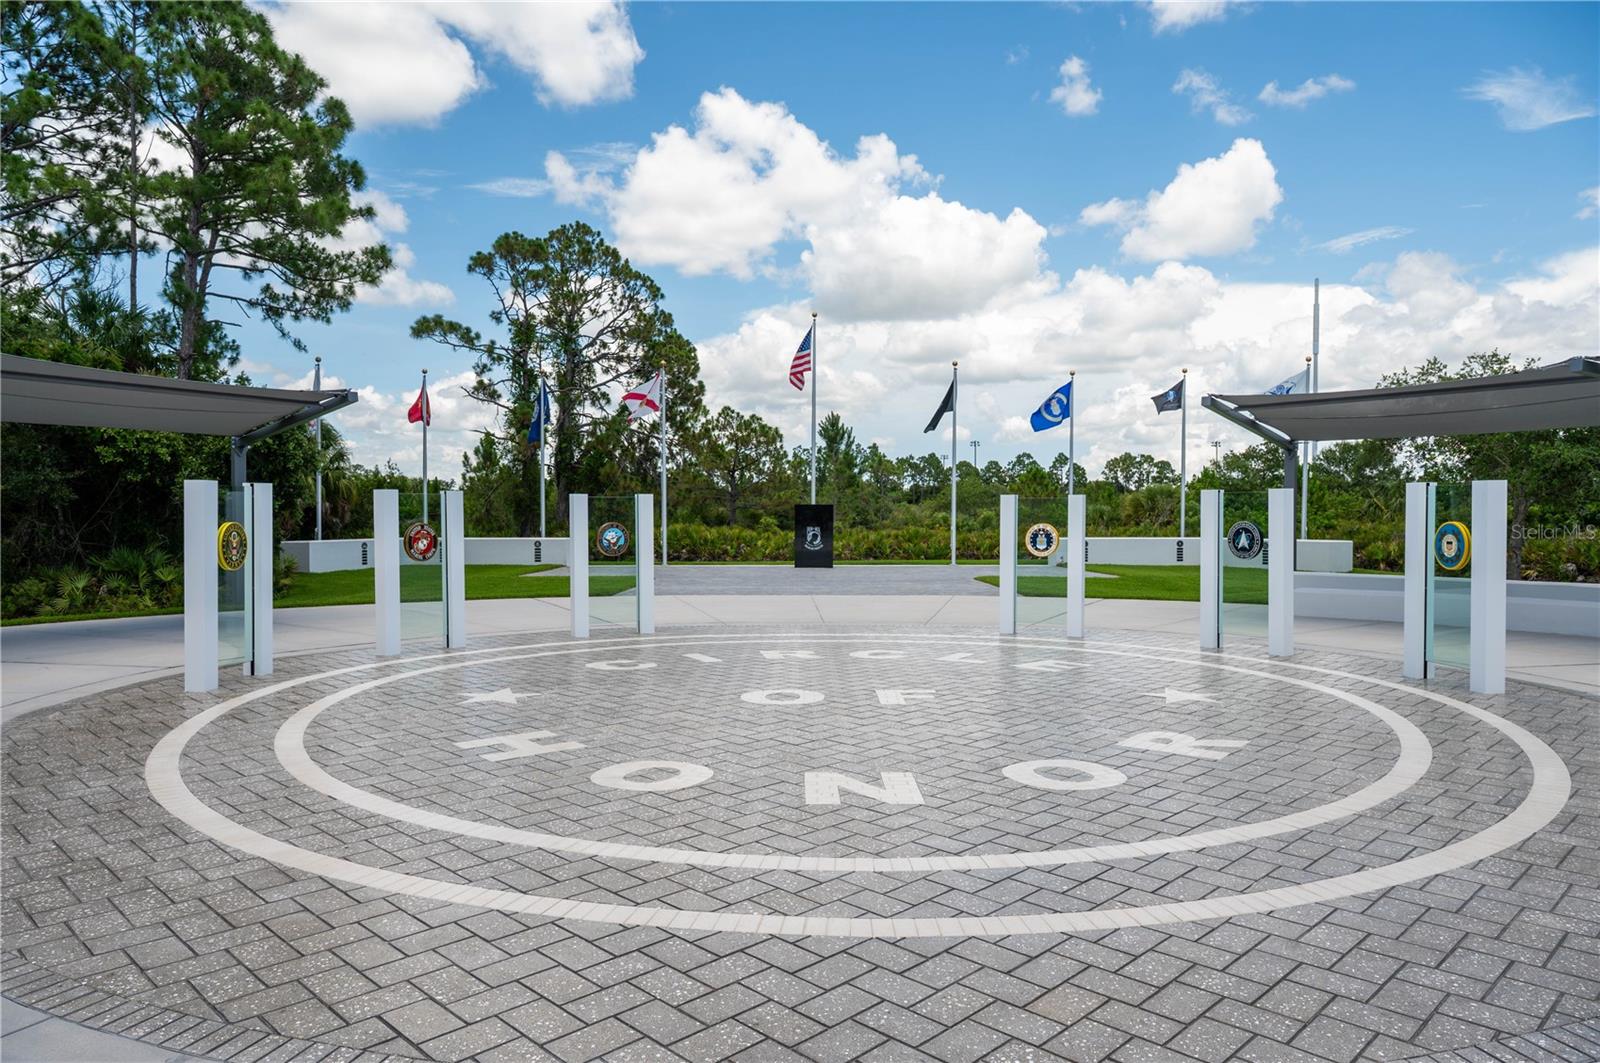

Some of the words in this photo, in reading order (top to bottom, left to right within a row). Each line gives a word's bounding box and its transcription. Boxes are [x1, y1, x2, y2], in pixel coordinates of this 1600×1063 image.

[585, 650, 1092, 672] CIRCLE
[740, 689, 937, 705] OF
[454, 730, 1251, 805] HONOR
